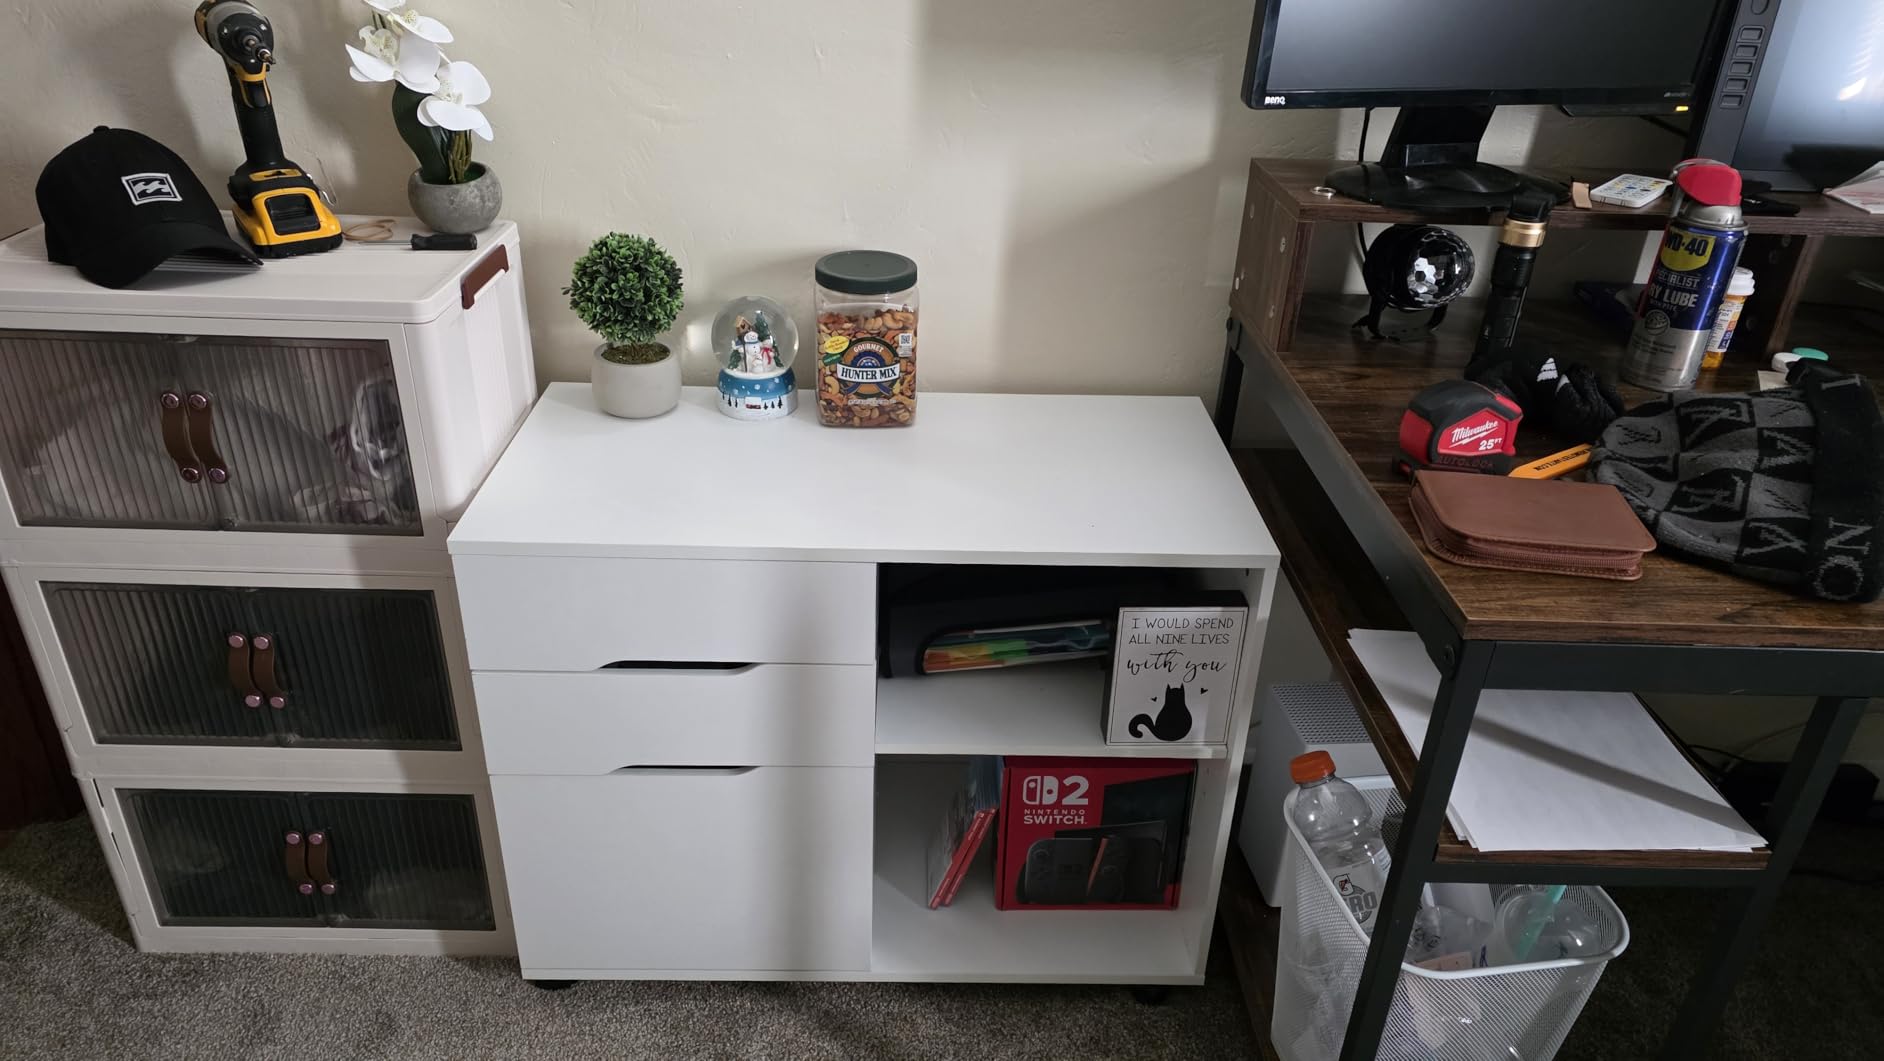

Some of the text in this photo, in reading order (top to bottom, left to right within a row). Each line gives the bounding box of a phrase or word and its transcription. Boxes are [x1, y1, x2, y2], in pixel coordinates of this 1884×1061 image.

[1648, 282, 1700, 308] RY LUBE
[853, 343, 884, 353] GOURMET
[841, 367, 898, 380] HUNTER MIX
[1451, 420, 1499, 443] Milwaukee
[1131, 617, 1234, 629] I WOULD SPEND
[1128, 633, 1230, 645] ALL NINE LIVES
[1127, 649, 1228, 683] with you
[1061, 775, 1089, 805] 2
